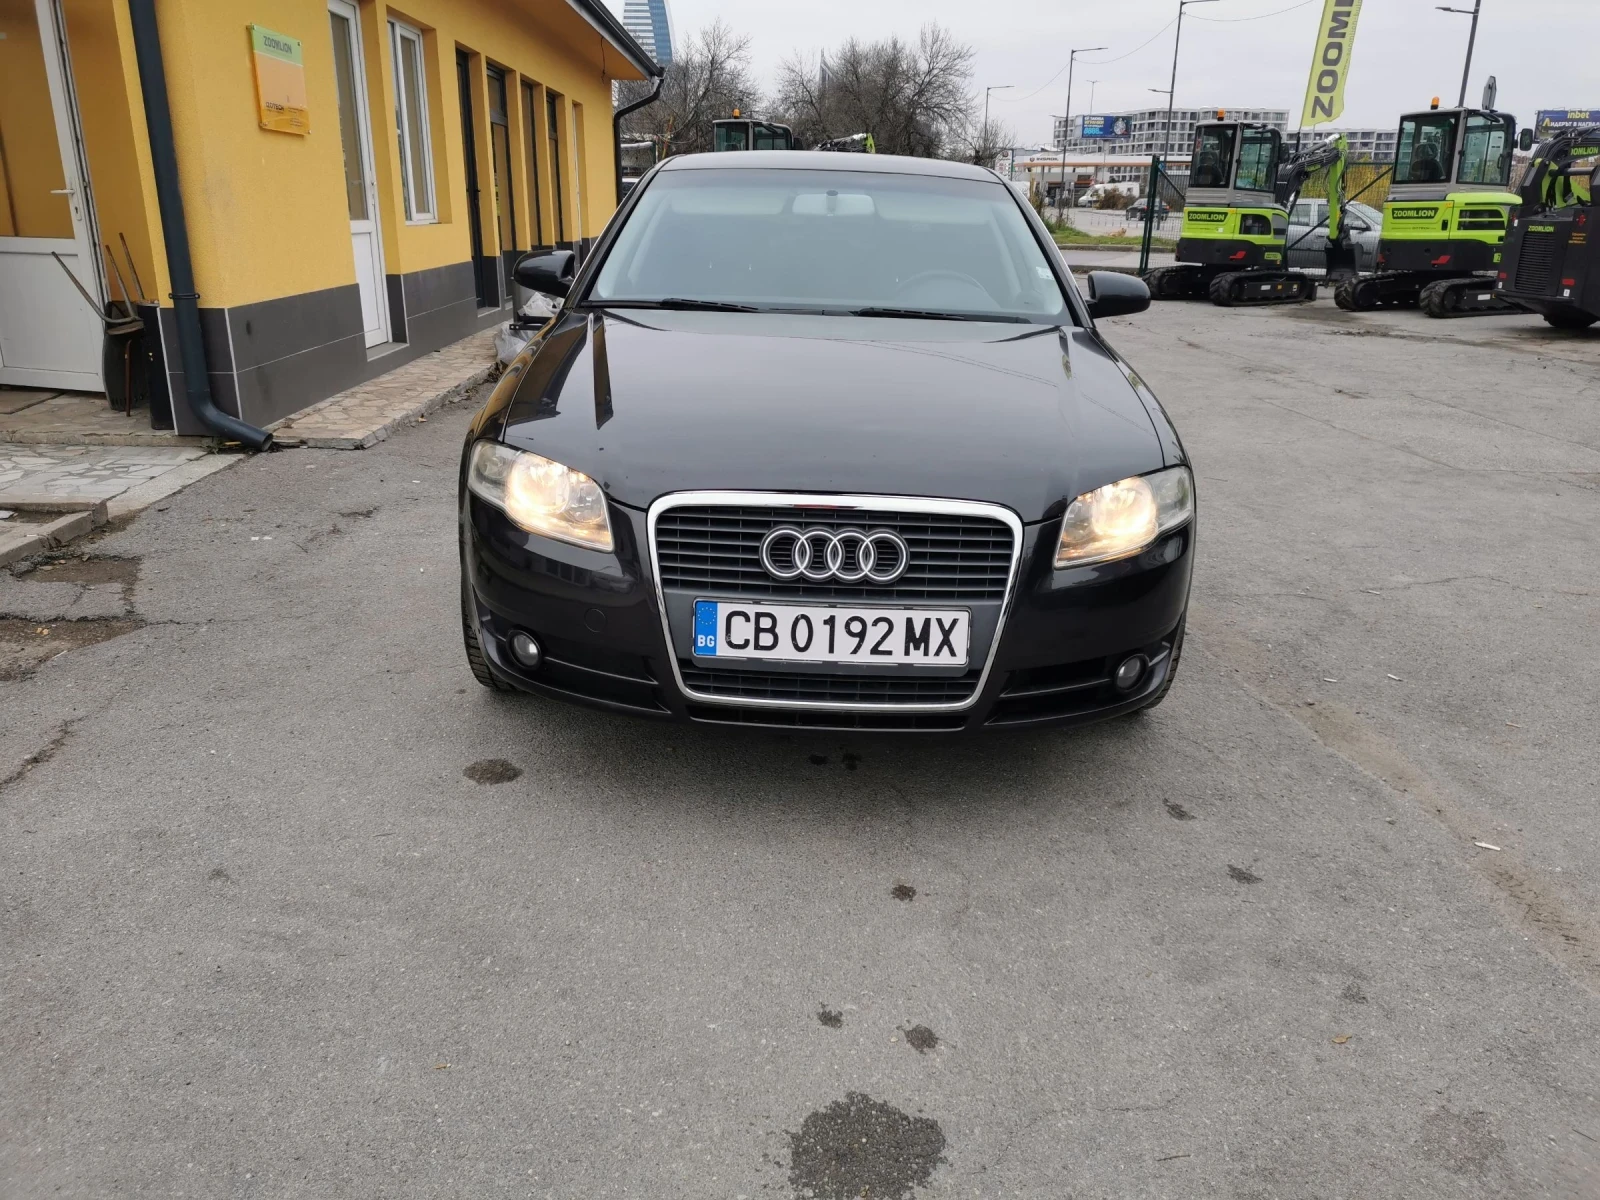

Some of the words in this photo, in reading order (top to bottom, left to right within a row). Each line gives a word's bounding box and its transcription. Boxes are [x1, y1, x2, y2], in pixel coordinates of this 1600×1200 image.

[263, 35, 293, 55] ZOOMLION
[1567, 110, 1590, 119] inbet
[1188, 212, 1225, 221] ZOOMLION
[1393, 209, 1435, 218] ZOOMLION
[1527, 225, 1555, 233] ZOOMLION
[724, 610, 780, 652] CB
[790, 613, 895, 657] 0192
[903, 616, 961, 658] MX
[697, 634, 716, 648] BG
